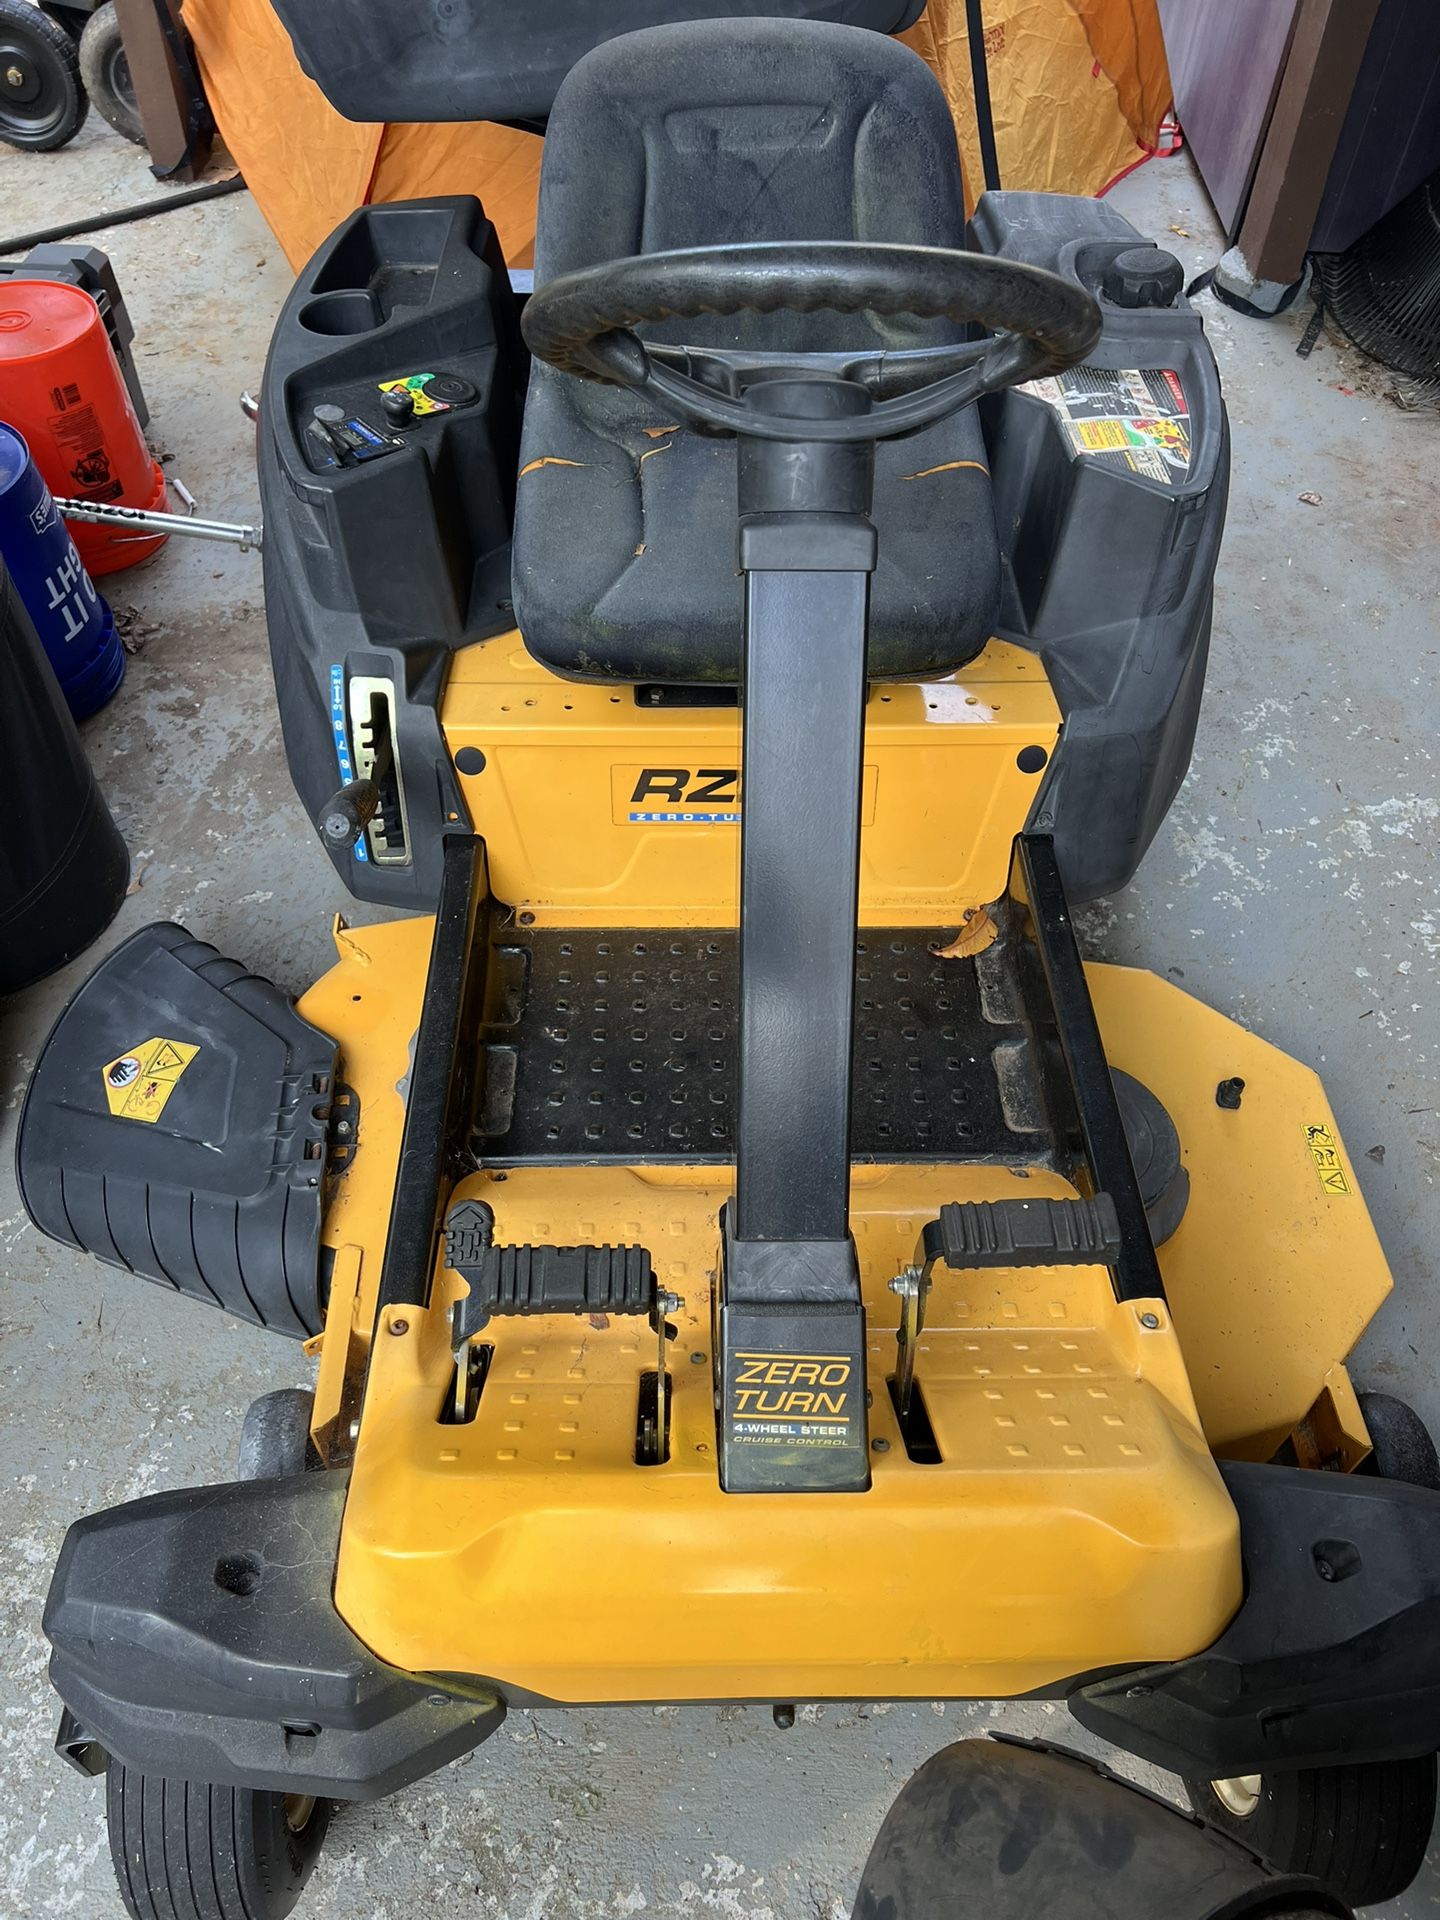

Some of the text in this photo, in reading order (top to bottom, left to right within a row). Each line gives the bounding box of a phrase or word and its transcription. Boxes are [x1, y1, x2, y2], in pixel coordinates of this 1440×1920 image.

[60, 591, 90, 642] IT
[334, 719, 343, 731] 8
[338, 740, 347, 750] 7
[340, 758, 349, 769] 6
[630, 769, 742, 803] RZ
[357, 847, 365, 857] 1
[735, 1361, 851, 1386] ZERO
[735, 1390, 847, 1414] TURN
[800, 1426, 847, 1435] STEER
[733, 1436, 849, 1446] CRUISE CONTROL
